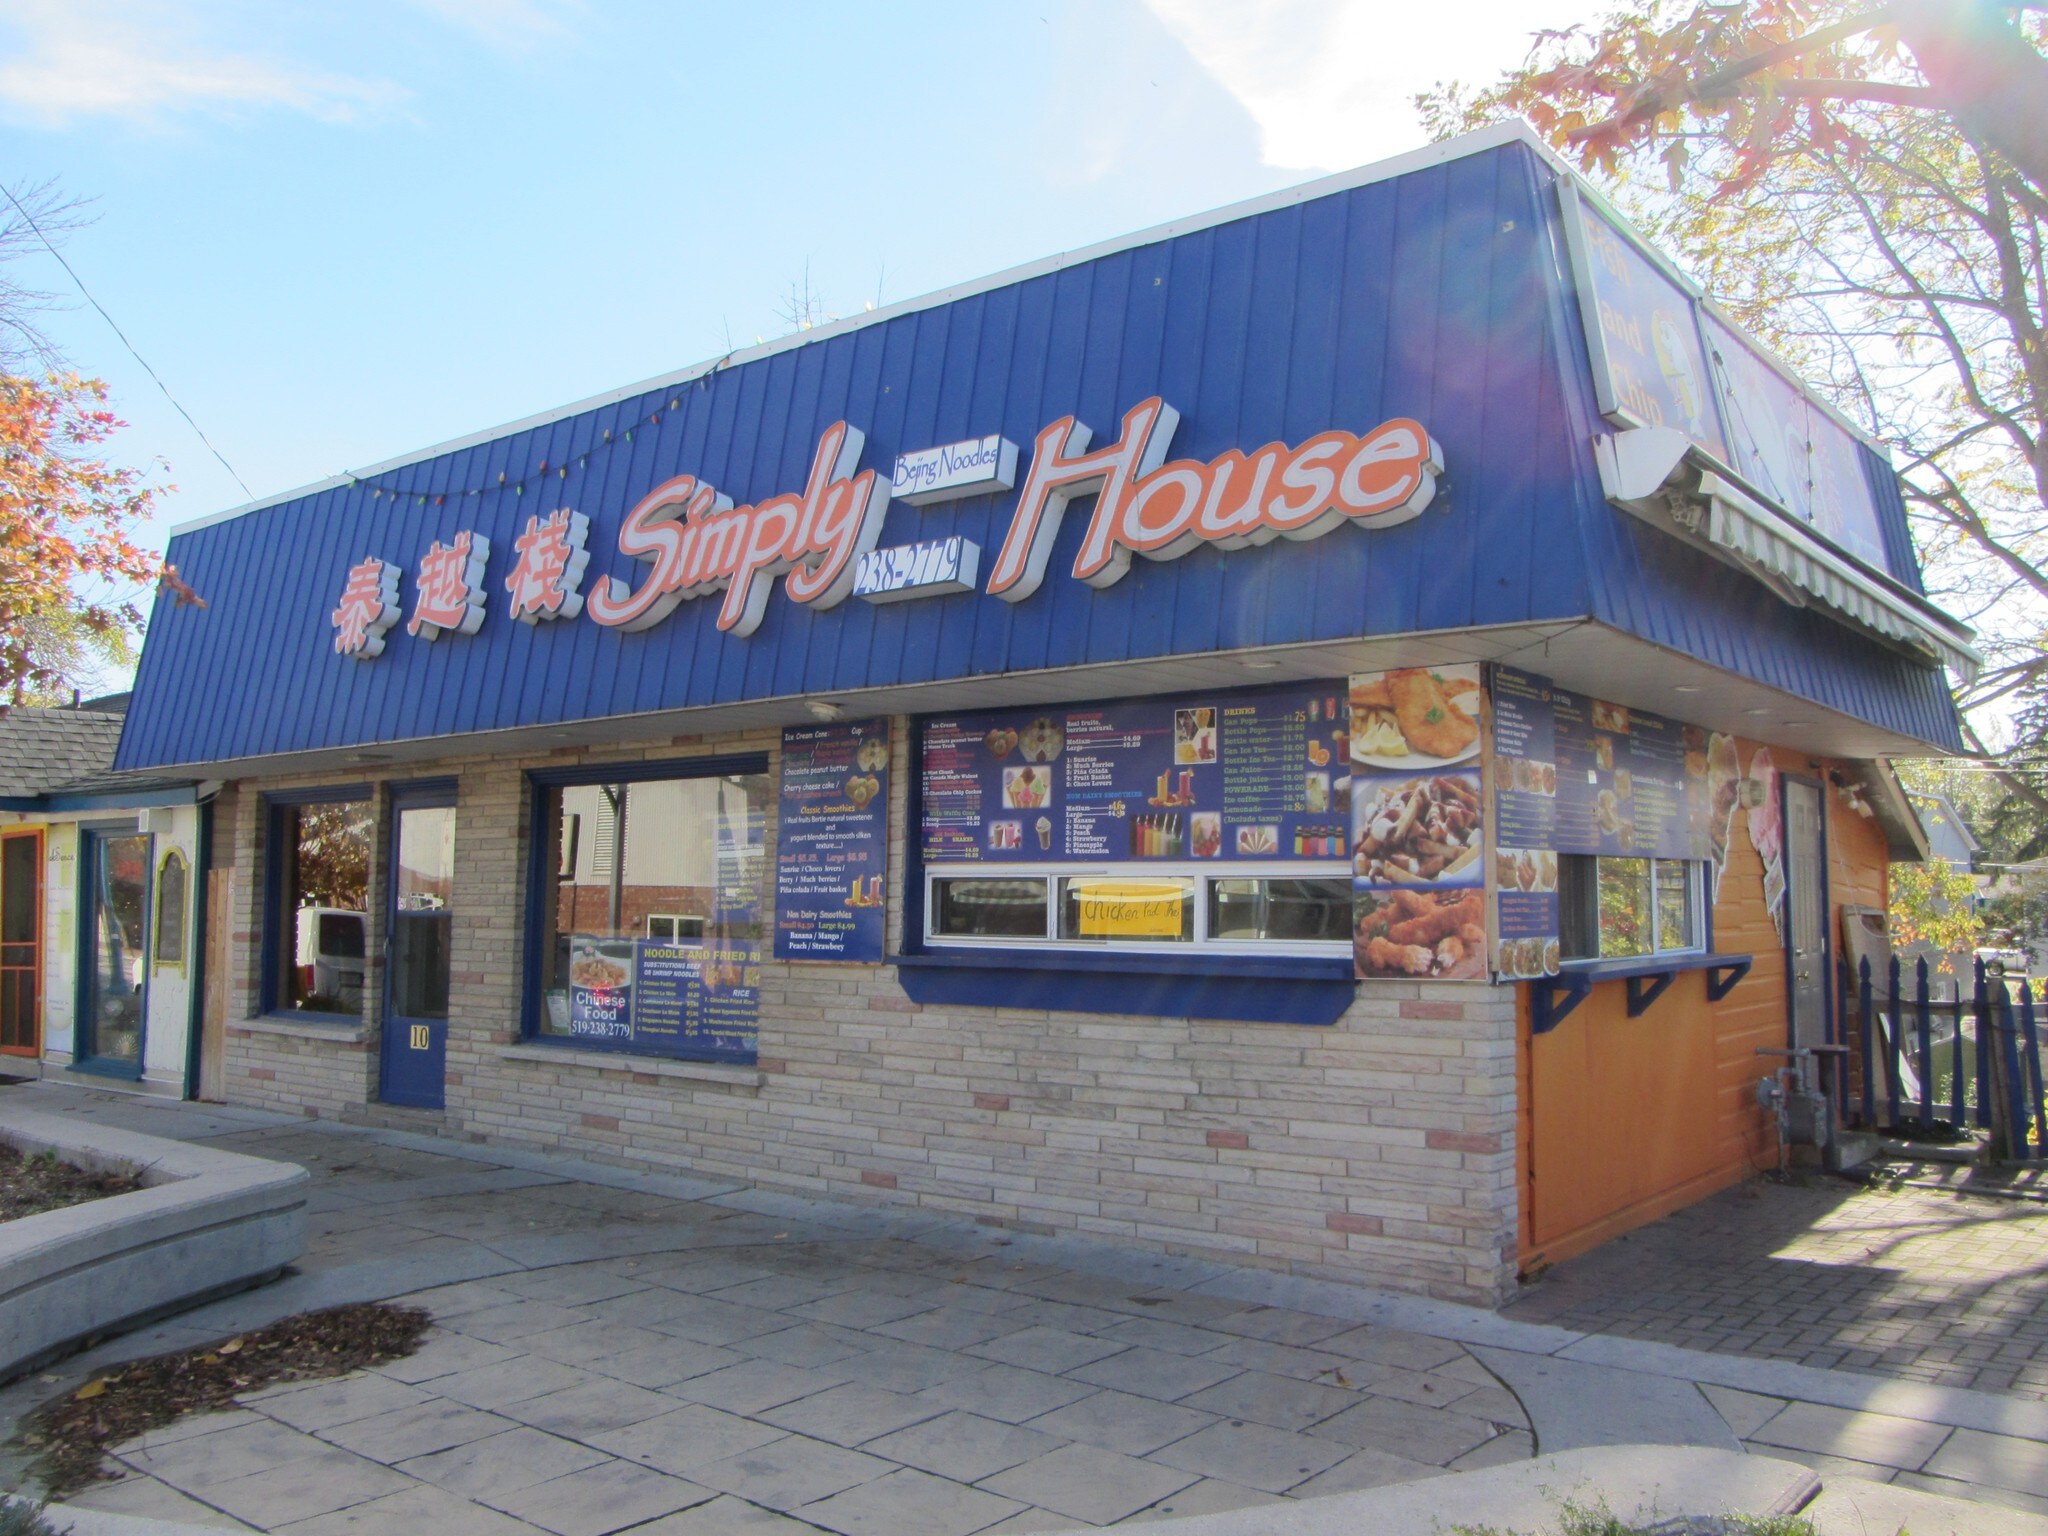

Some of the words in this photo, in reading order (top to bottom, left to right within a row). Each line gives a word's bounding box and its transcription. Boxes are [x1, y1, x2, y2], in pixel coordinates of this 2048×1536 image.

[938, 439, 997, 479] Noodles
[986, 396, 1431, 594] House
[587, 420, 876, 631] Simply
[854, 536, 960, 597] 238-2779
[785, 733, 794, 741] Ice
[796, 732, 813, 740] Cream
[785, 768, 809, 776] Chocolate
[830, 765, 849, 773] butter
[800, 805, 821, 814] Classic
[823, 803, 855, 813] Smoothies
[790, 834, 806, 843] yogurt
[835, 831, 855, 840] smooth
[813, 885, 828, 893] Fruit
[801, 910, 817, 920] Dairy
[819, 910, 852, 919] Smoothies
[818, 932, 840, 941] Mango
[789, 942, 807, 950] Peach
[644, 948, 685, 959] NOODLE
[687, 949, 710, 960] AND
[713, 950, 746, 961] FRIED
[673, 970, 700, 978] NOODLES
[576, 991, 626, 1007] Chinese
[732, 989, 751, 998] RICE
[584, 1006, 617, 1021] Food
[412, 1026, 428, 1048] 10
